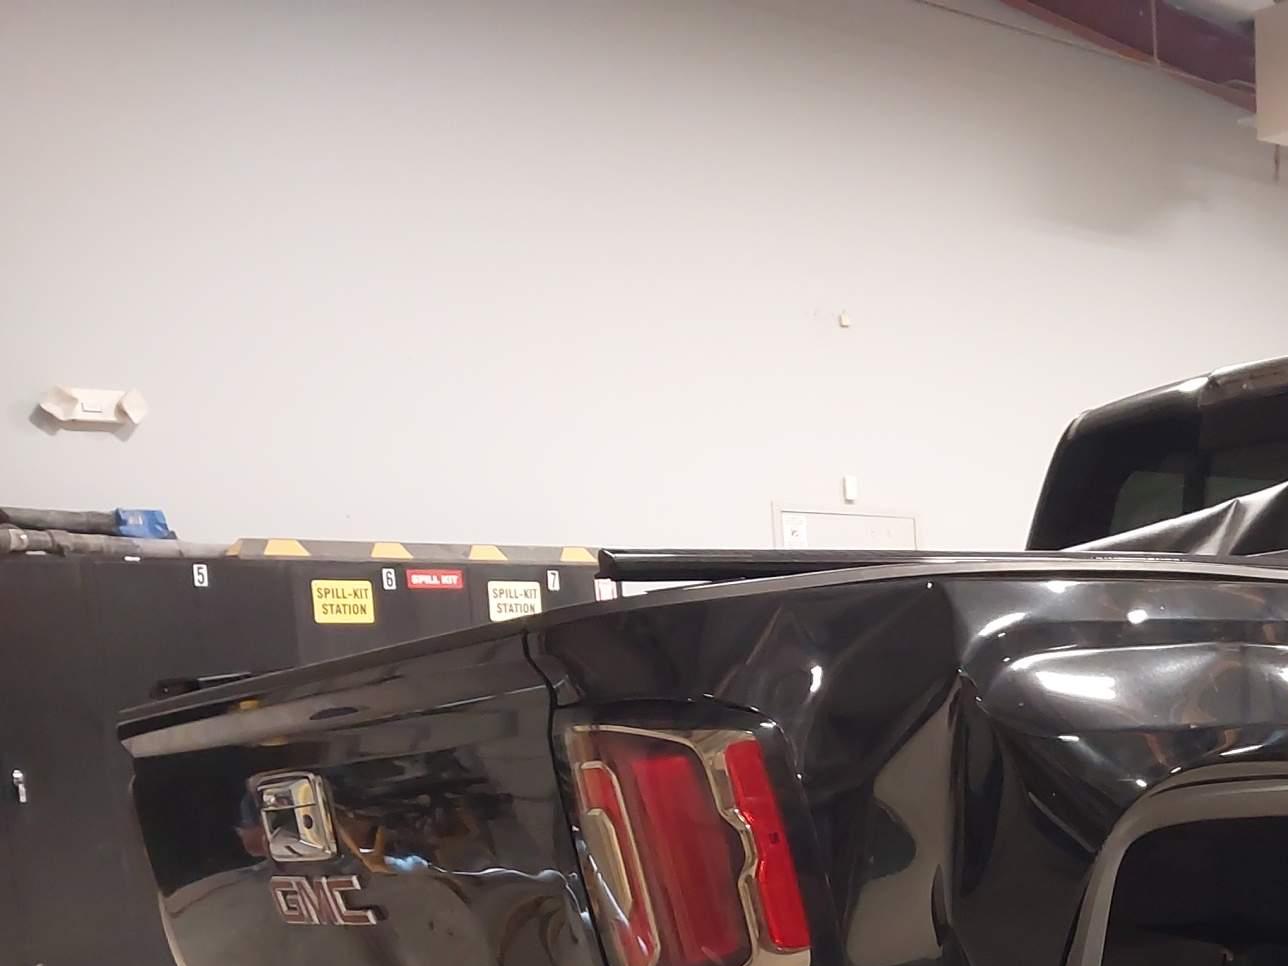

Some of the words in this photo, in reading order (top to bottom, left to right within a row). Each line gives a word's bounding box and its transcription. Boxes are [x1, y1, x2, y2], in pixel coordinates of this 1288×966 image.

[196, 566, 205, 585] 5
[384, 570, 394, 587] 6
[411, 573, 439, 585] SPILL
[441, 573, 460, 585] KIT
[549, 571, 557, 588] 7
[316, 587, 369, 600] SPILL-KIT
[492, 587, 538, 600] SPILL-KIT
[321, 603, 368, 616] STATION
[496, 603, 536, 615] STATION
[271, 875, 377, 925] GMC
